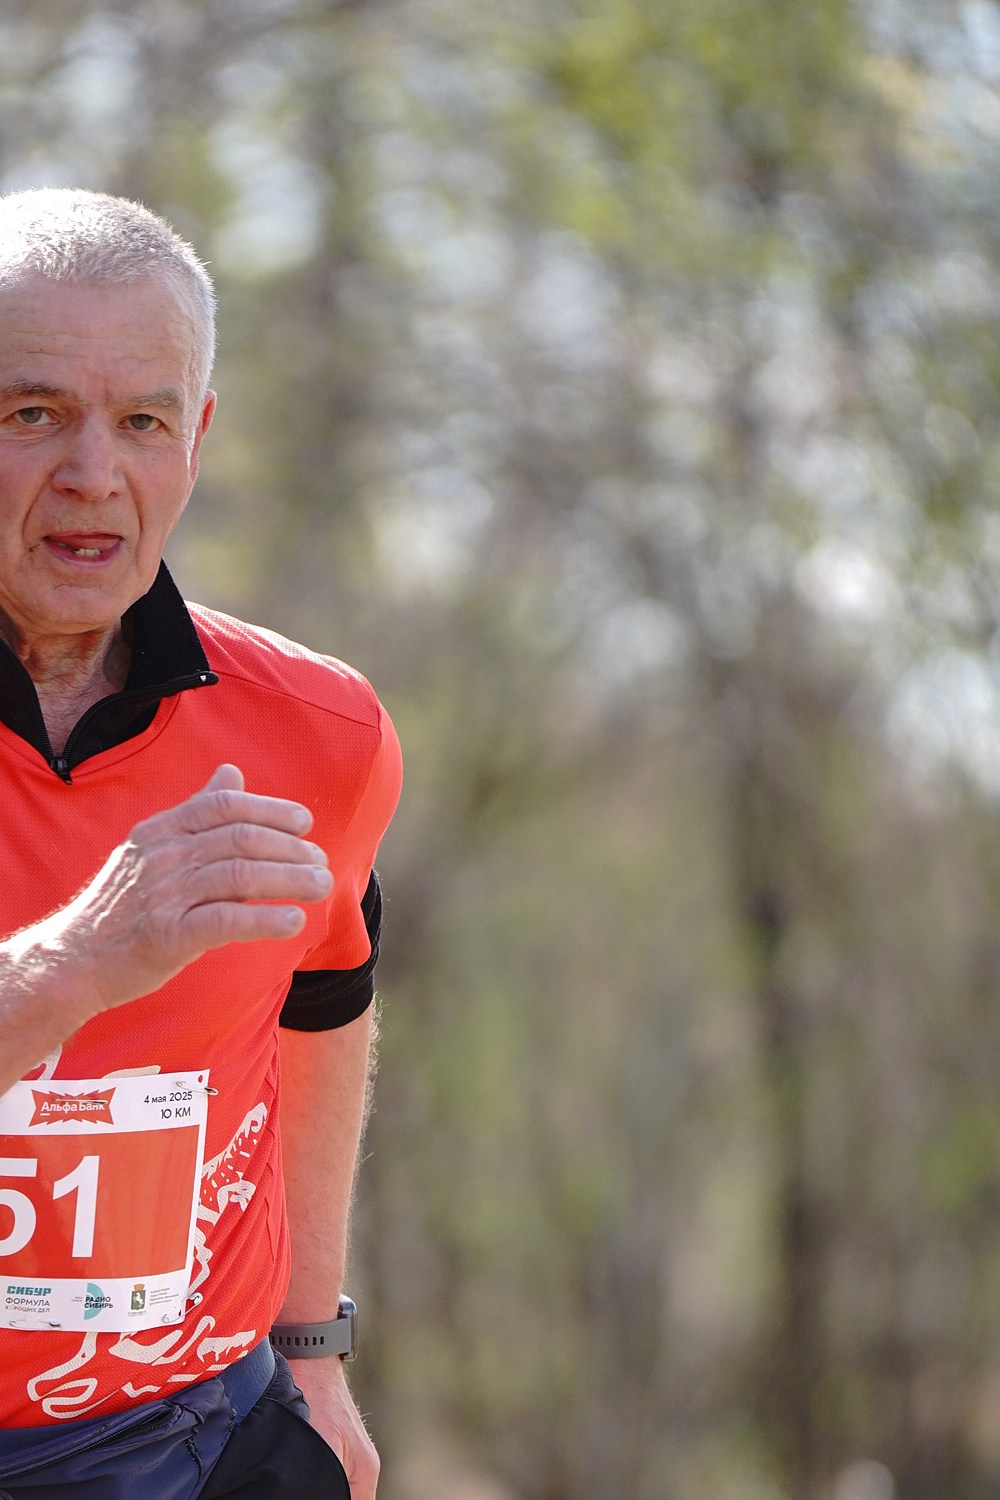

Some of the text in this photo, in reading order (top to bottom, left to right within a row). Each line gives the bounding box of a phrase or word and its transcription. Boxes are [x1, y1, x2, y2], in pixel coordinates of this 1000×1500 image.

[144, 1091, 193, 1104] 4 мая 2025
[40, 1101, 77, 1115] Альфа
[161, 1108, 172, 1119] 10
[6, 1285, 52, 1297] СИБУР
[5, 1297, 50, 1307] ФОРМУЛА
